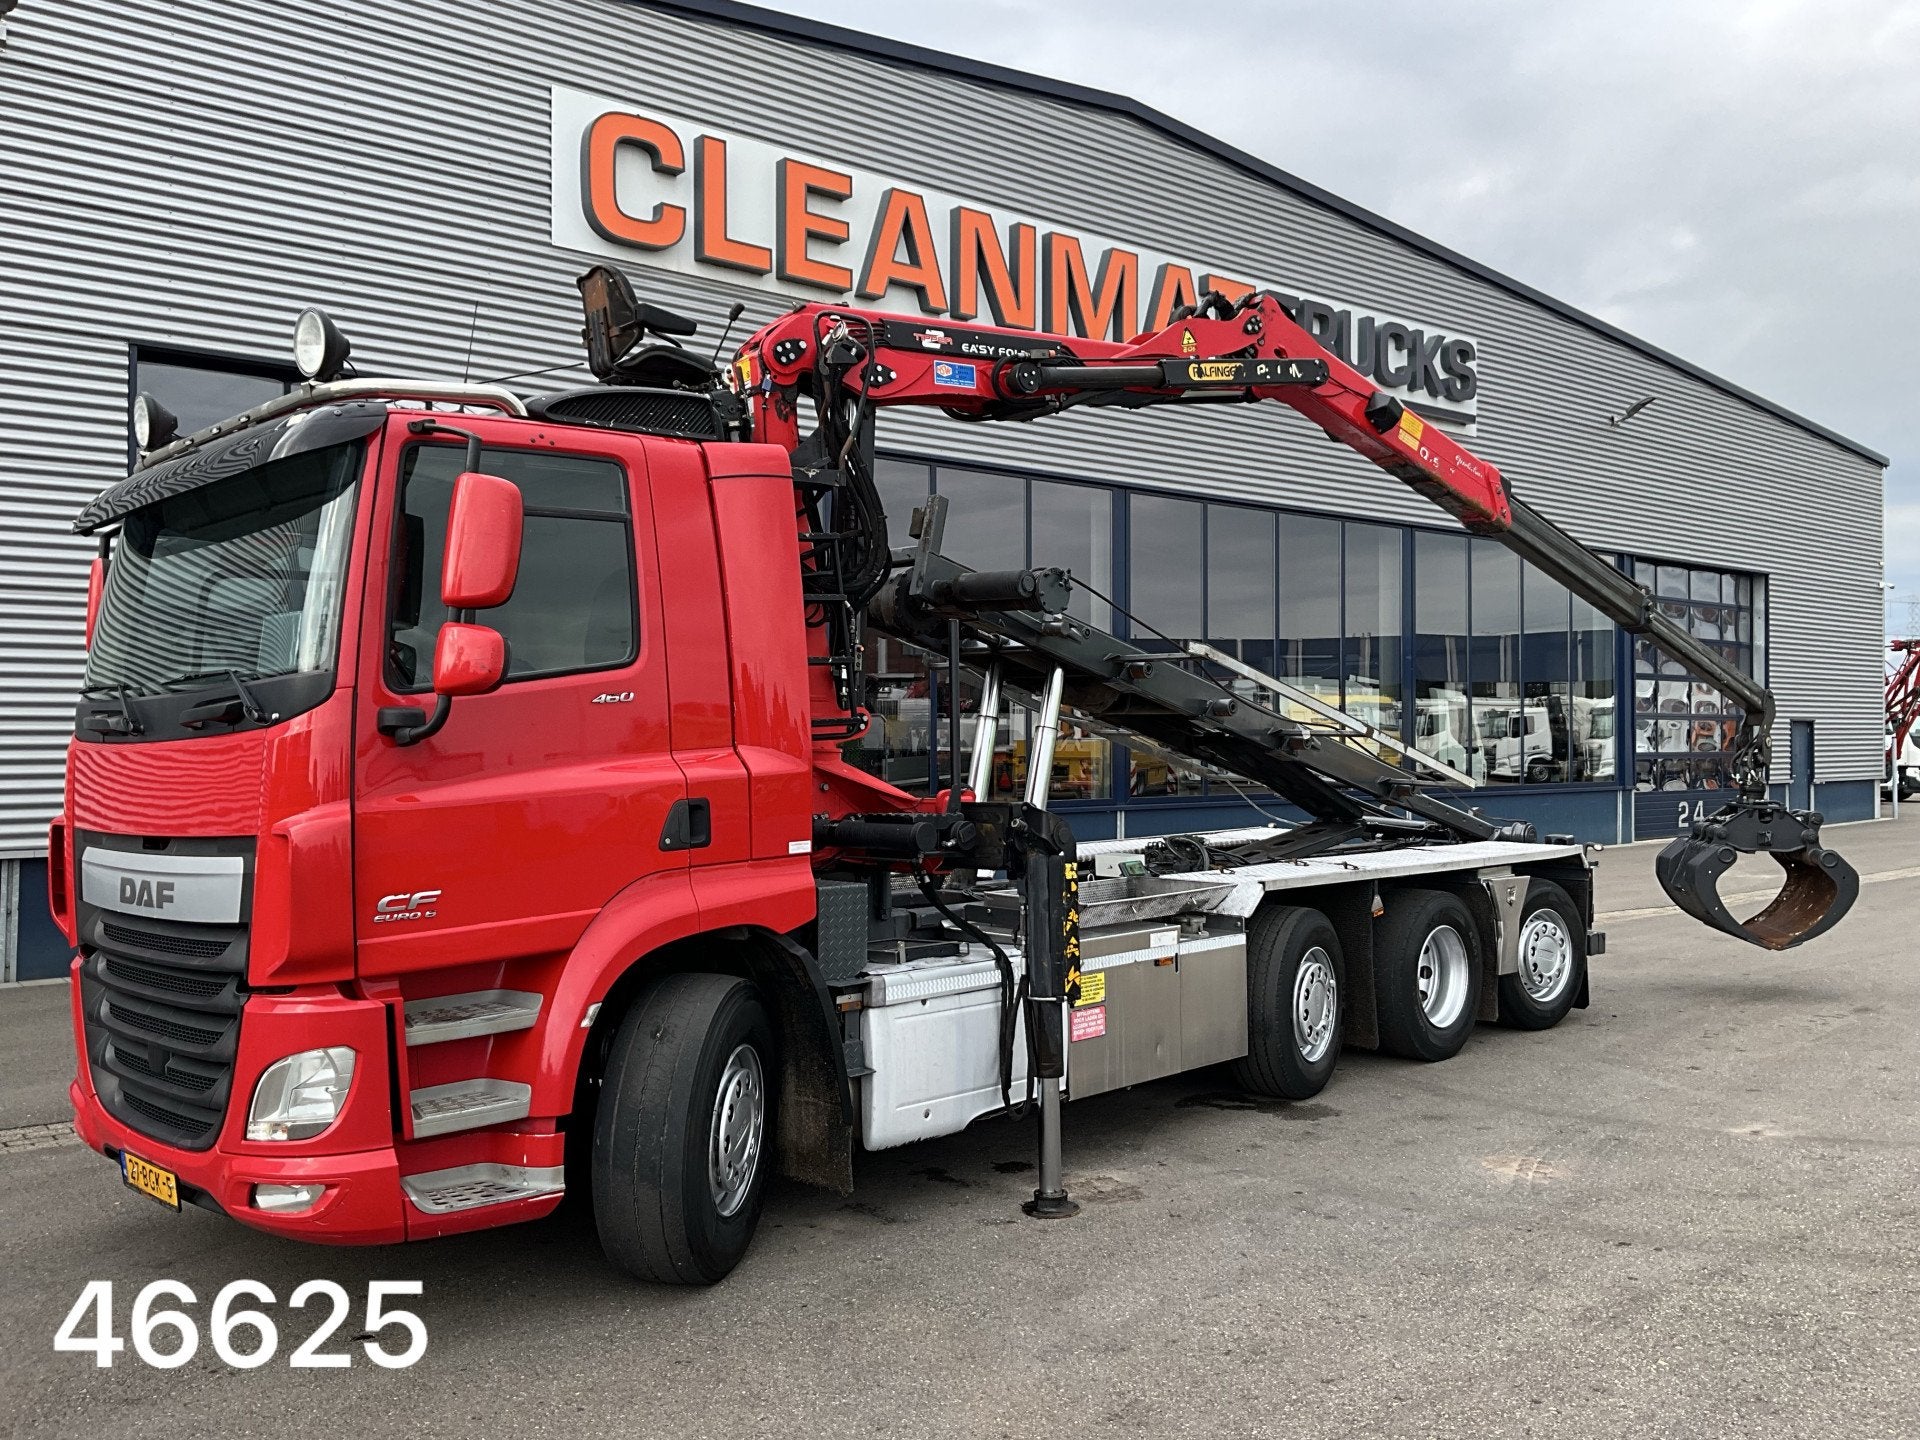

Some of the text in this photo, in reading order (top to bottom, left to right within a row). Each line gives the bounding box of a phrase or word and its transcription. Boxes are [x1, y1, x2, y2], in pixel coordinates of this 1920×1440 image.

[961, 343, 995, 356] EASY
[591, 692, 635, 704] 460
[1678, 800, 1705, 828] 24
[119, 876, 175, 909] DAF
[377, 889, 442, 913] CF
[373, 911, 422, 923] EURO
